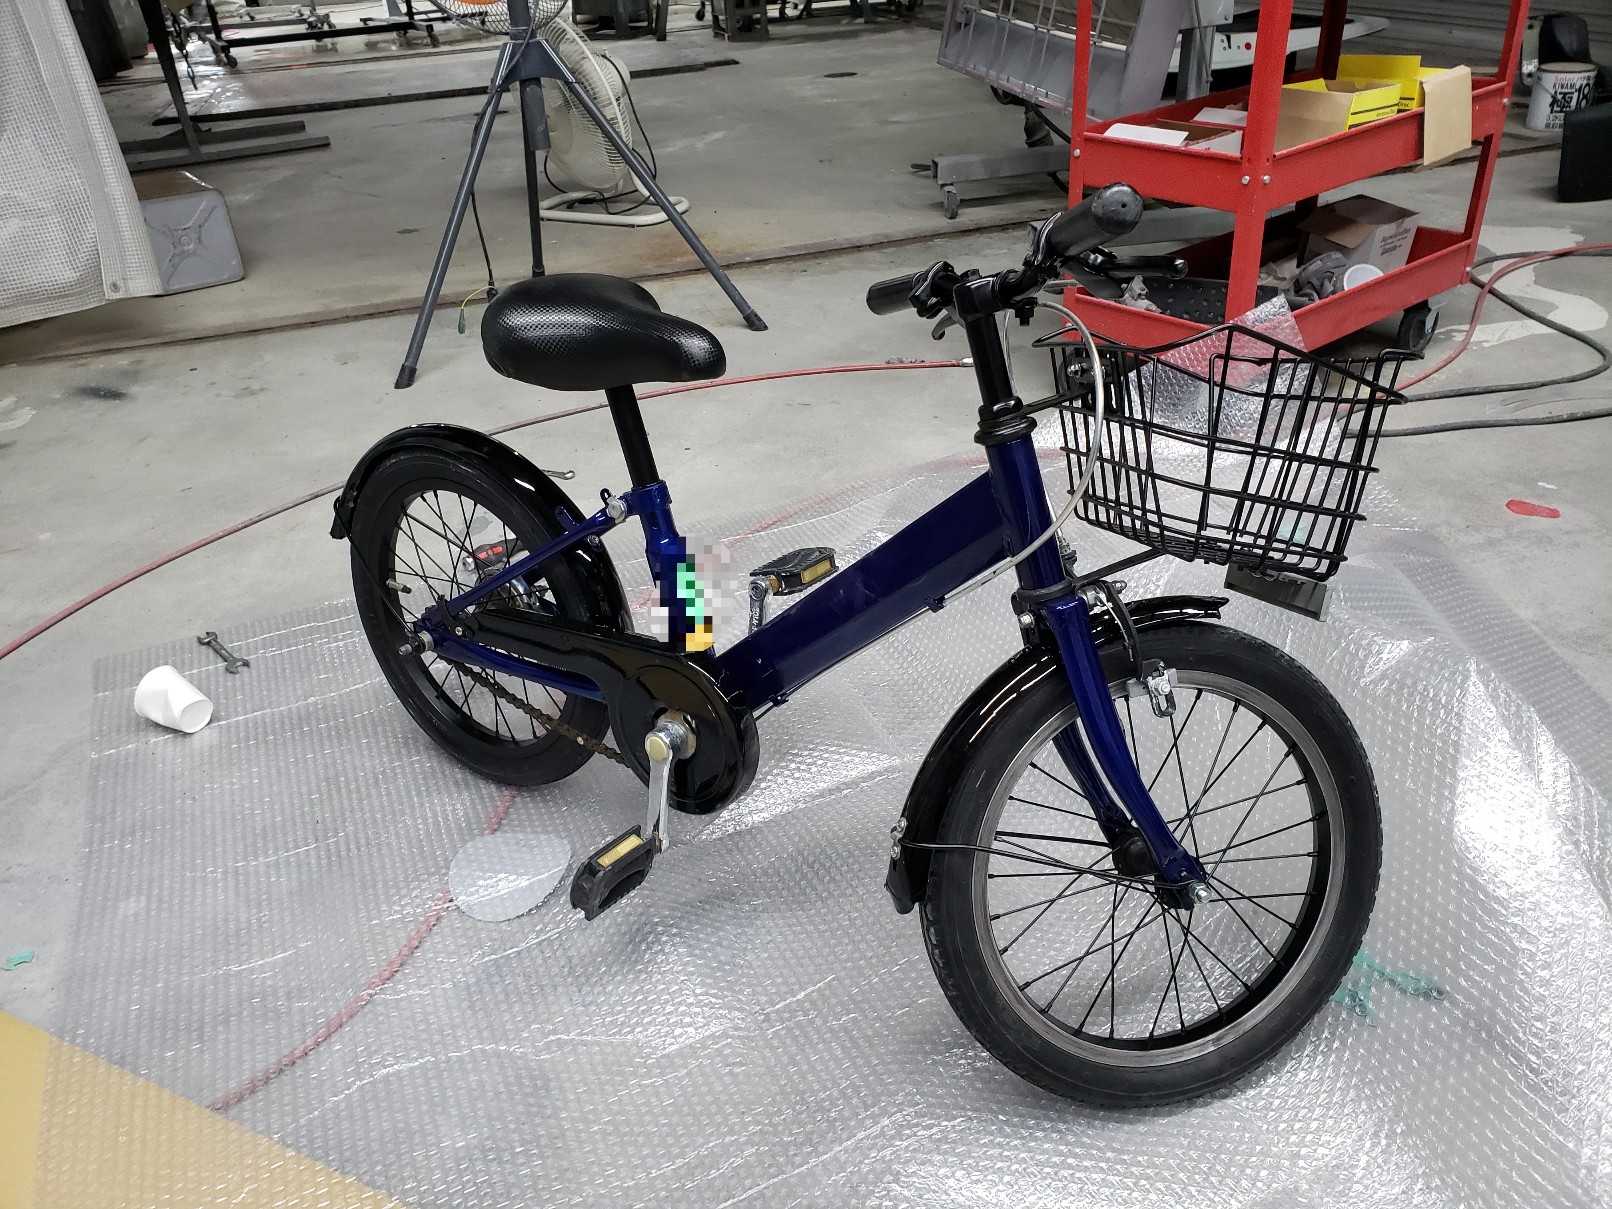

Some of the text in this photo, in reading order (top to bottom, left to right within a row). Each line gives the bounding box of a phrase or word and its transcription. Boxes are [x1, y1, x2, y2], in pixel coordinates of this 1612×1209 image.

[1554, 75, 1575, 83] Solar
[1549, 82, 1591, 114] 極 18
